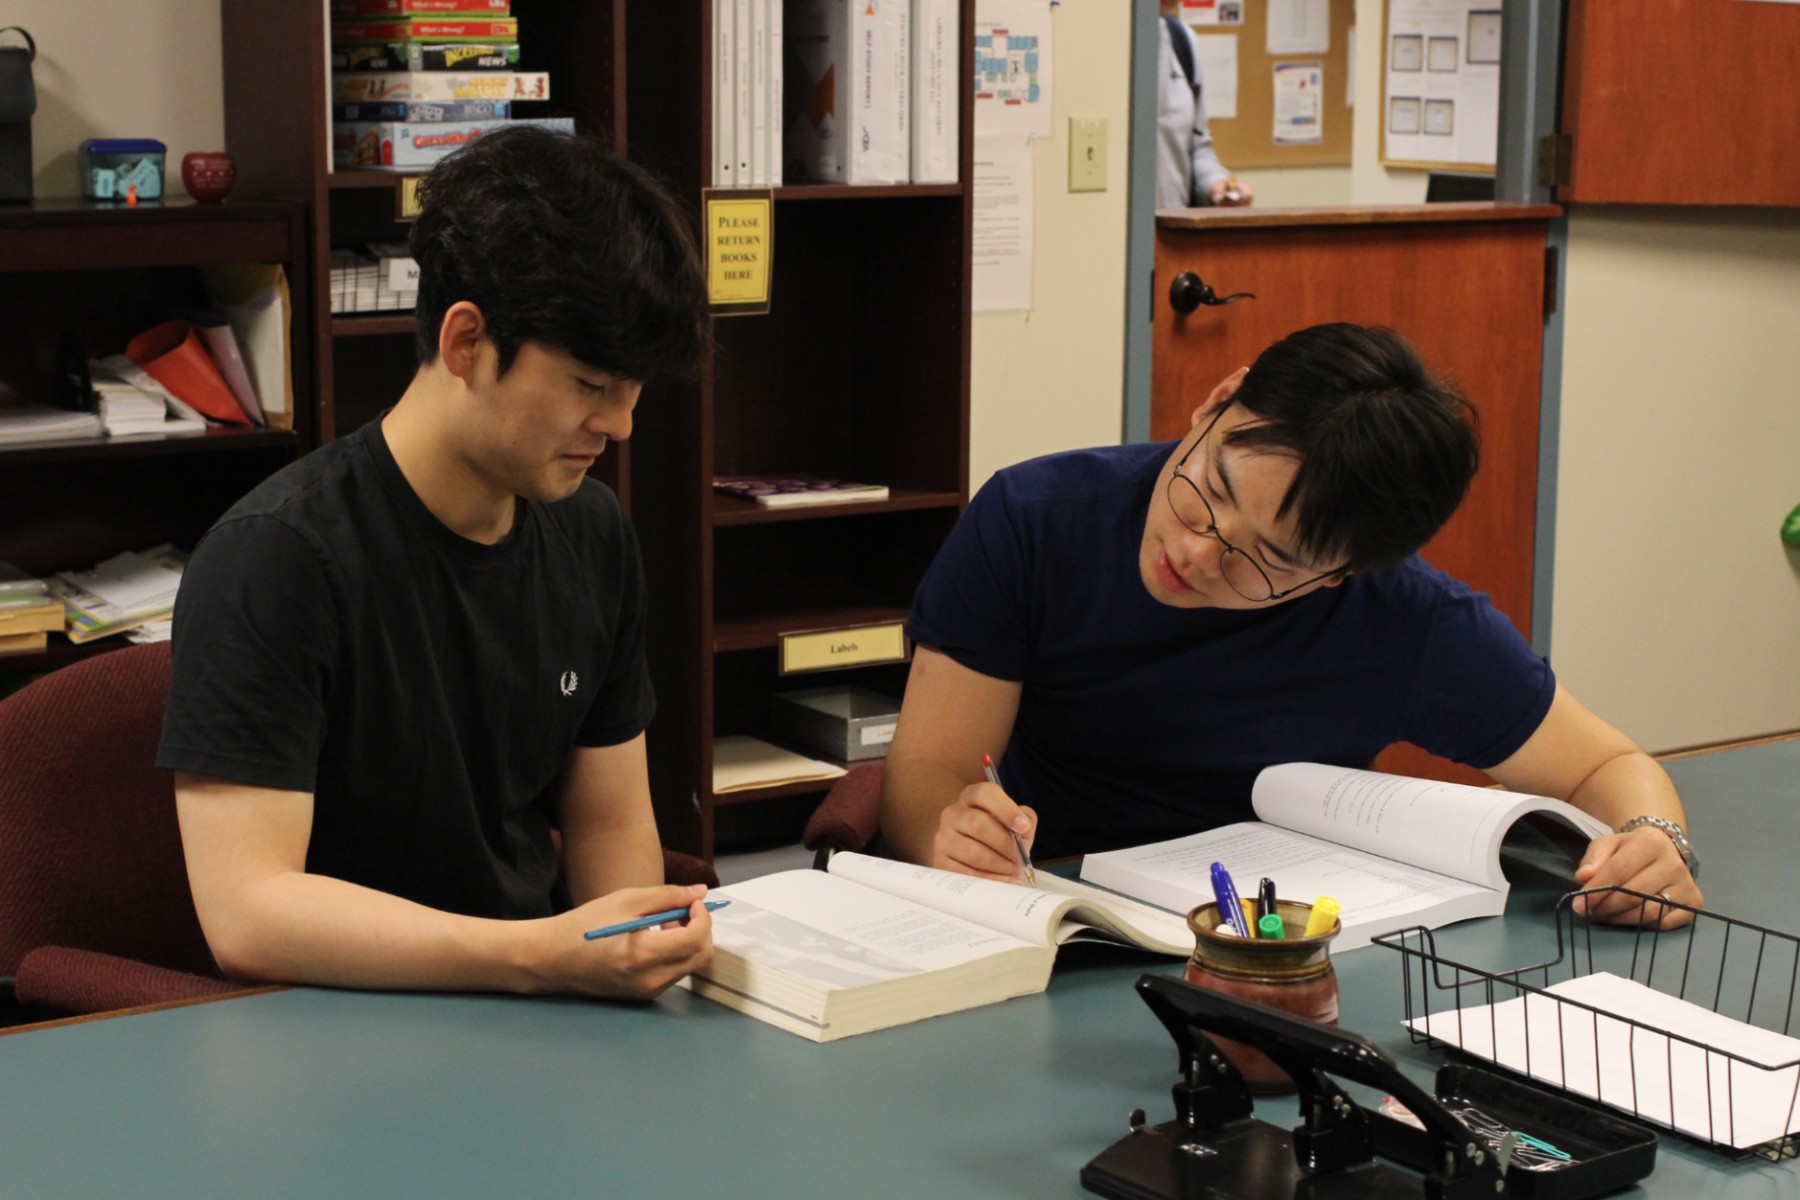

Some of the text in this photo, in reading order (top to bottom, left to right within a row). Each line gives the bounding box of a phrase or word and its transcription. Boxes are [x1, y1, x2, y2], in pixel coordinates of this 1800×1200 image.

[477, 56, 507, 67] NEWS
[718, 216, 760, 228] PLEASE
[717, 235, 761, 246] RETURN
[720, 252, 757, 263] BOOKS
[723, 270, 752, 280] HERE
[830, 642, 859, 654] Labels
